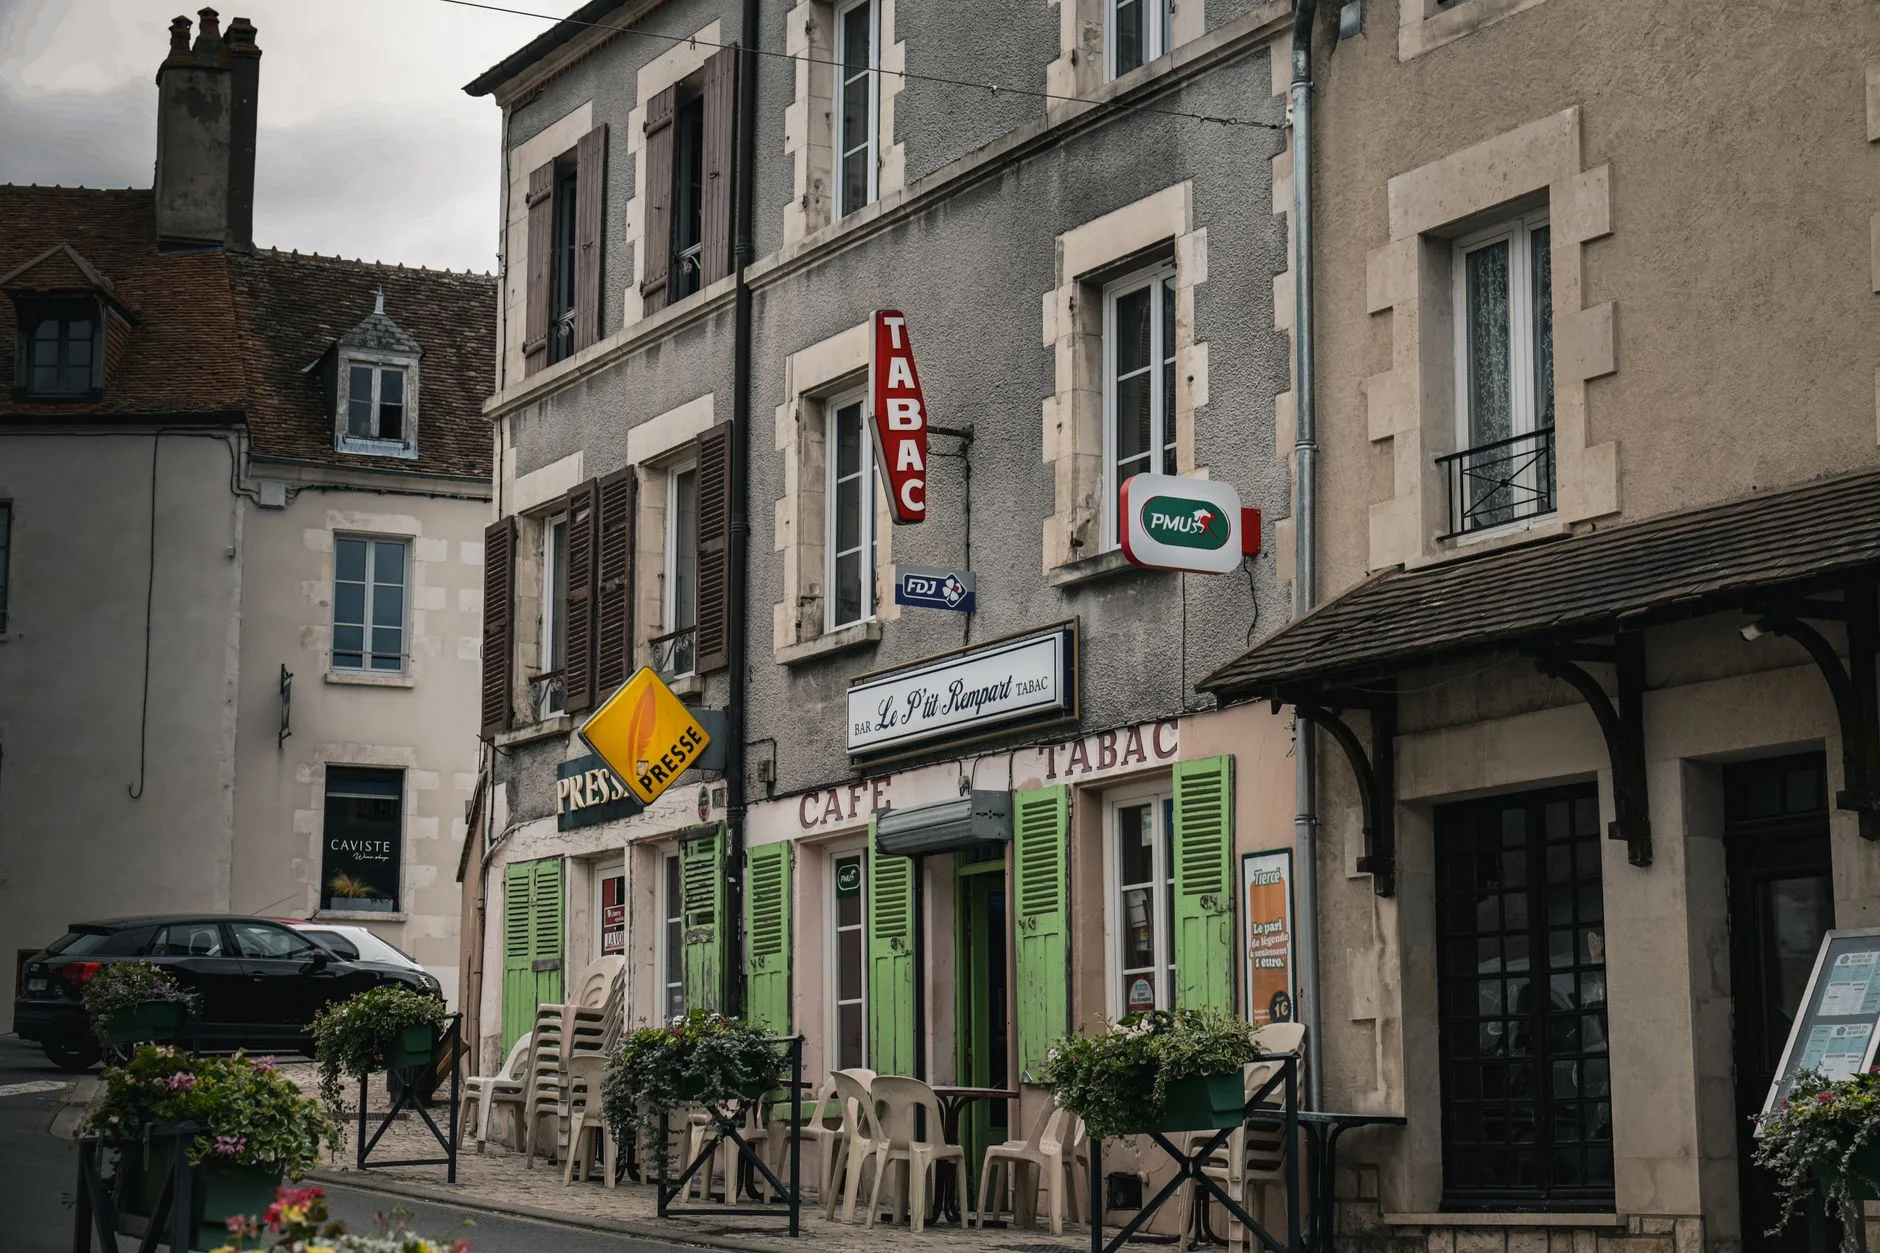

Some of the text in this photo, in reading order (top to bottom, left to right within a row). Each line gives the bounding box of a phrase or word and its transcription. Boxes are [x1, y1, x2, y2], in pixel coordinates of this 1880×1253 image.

[884, 316, 925, 512] TABAC
[1151, 512, 1191, 532] PMU
[907, 577, 937, 595] FDJ
[854, 675, 1048, 736] BAR Le P'tit Rempart TABAC
[1038, 718, 1178, 780] TABAC
[638, 726, 702, 794] PRESSE
[557, 768, 629, 814] PRESS
[799, 775, 891, 829] CAFE
[330, 838, 390, 852] CAVISTE
[1254, 867, 1280, 886] Tiercé
[1253, 919, 1282, 935] Le pari
[1251, 933, 1288, 947] de légende
[1261, 957, 1283, 967] euro.
[1274, 1000, 1289, 1018] 1€
